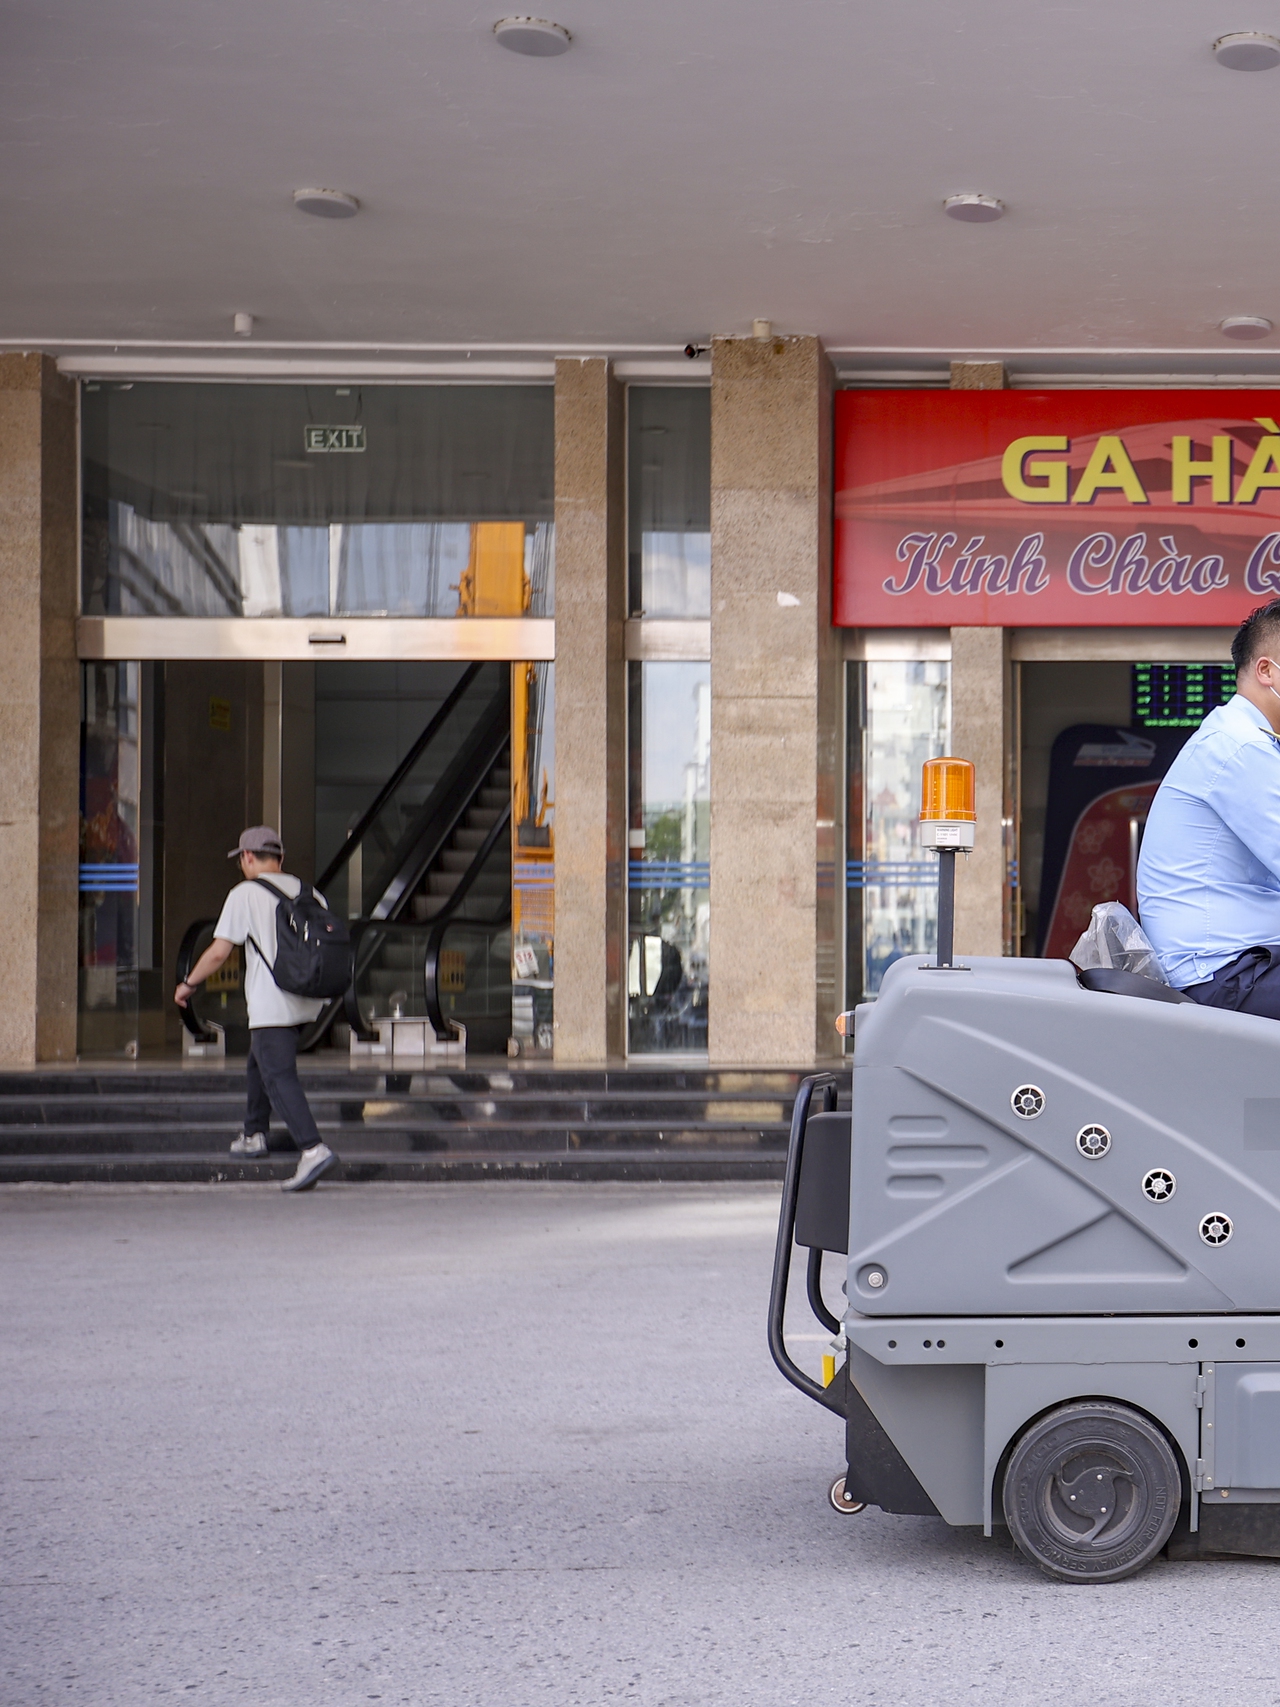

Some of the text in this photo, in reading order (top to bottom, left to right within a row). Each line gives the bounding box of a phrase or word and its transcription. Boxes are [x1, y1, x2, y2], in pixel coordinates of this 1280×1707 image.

[310, 430, 361, 447] EXIT
[1003, 436, 1148, 504] GA
[883, 531, 1051, 596] Kính
[1067, 531, 1230, 596] Chào
[1034, 1486, 1167, 1572] NOT FOR HIGHWAY SERVICE
